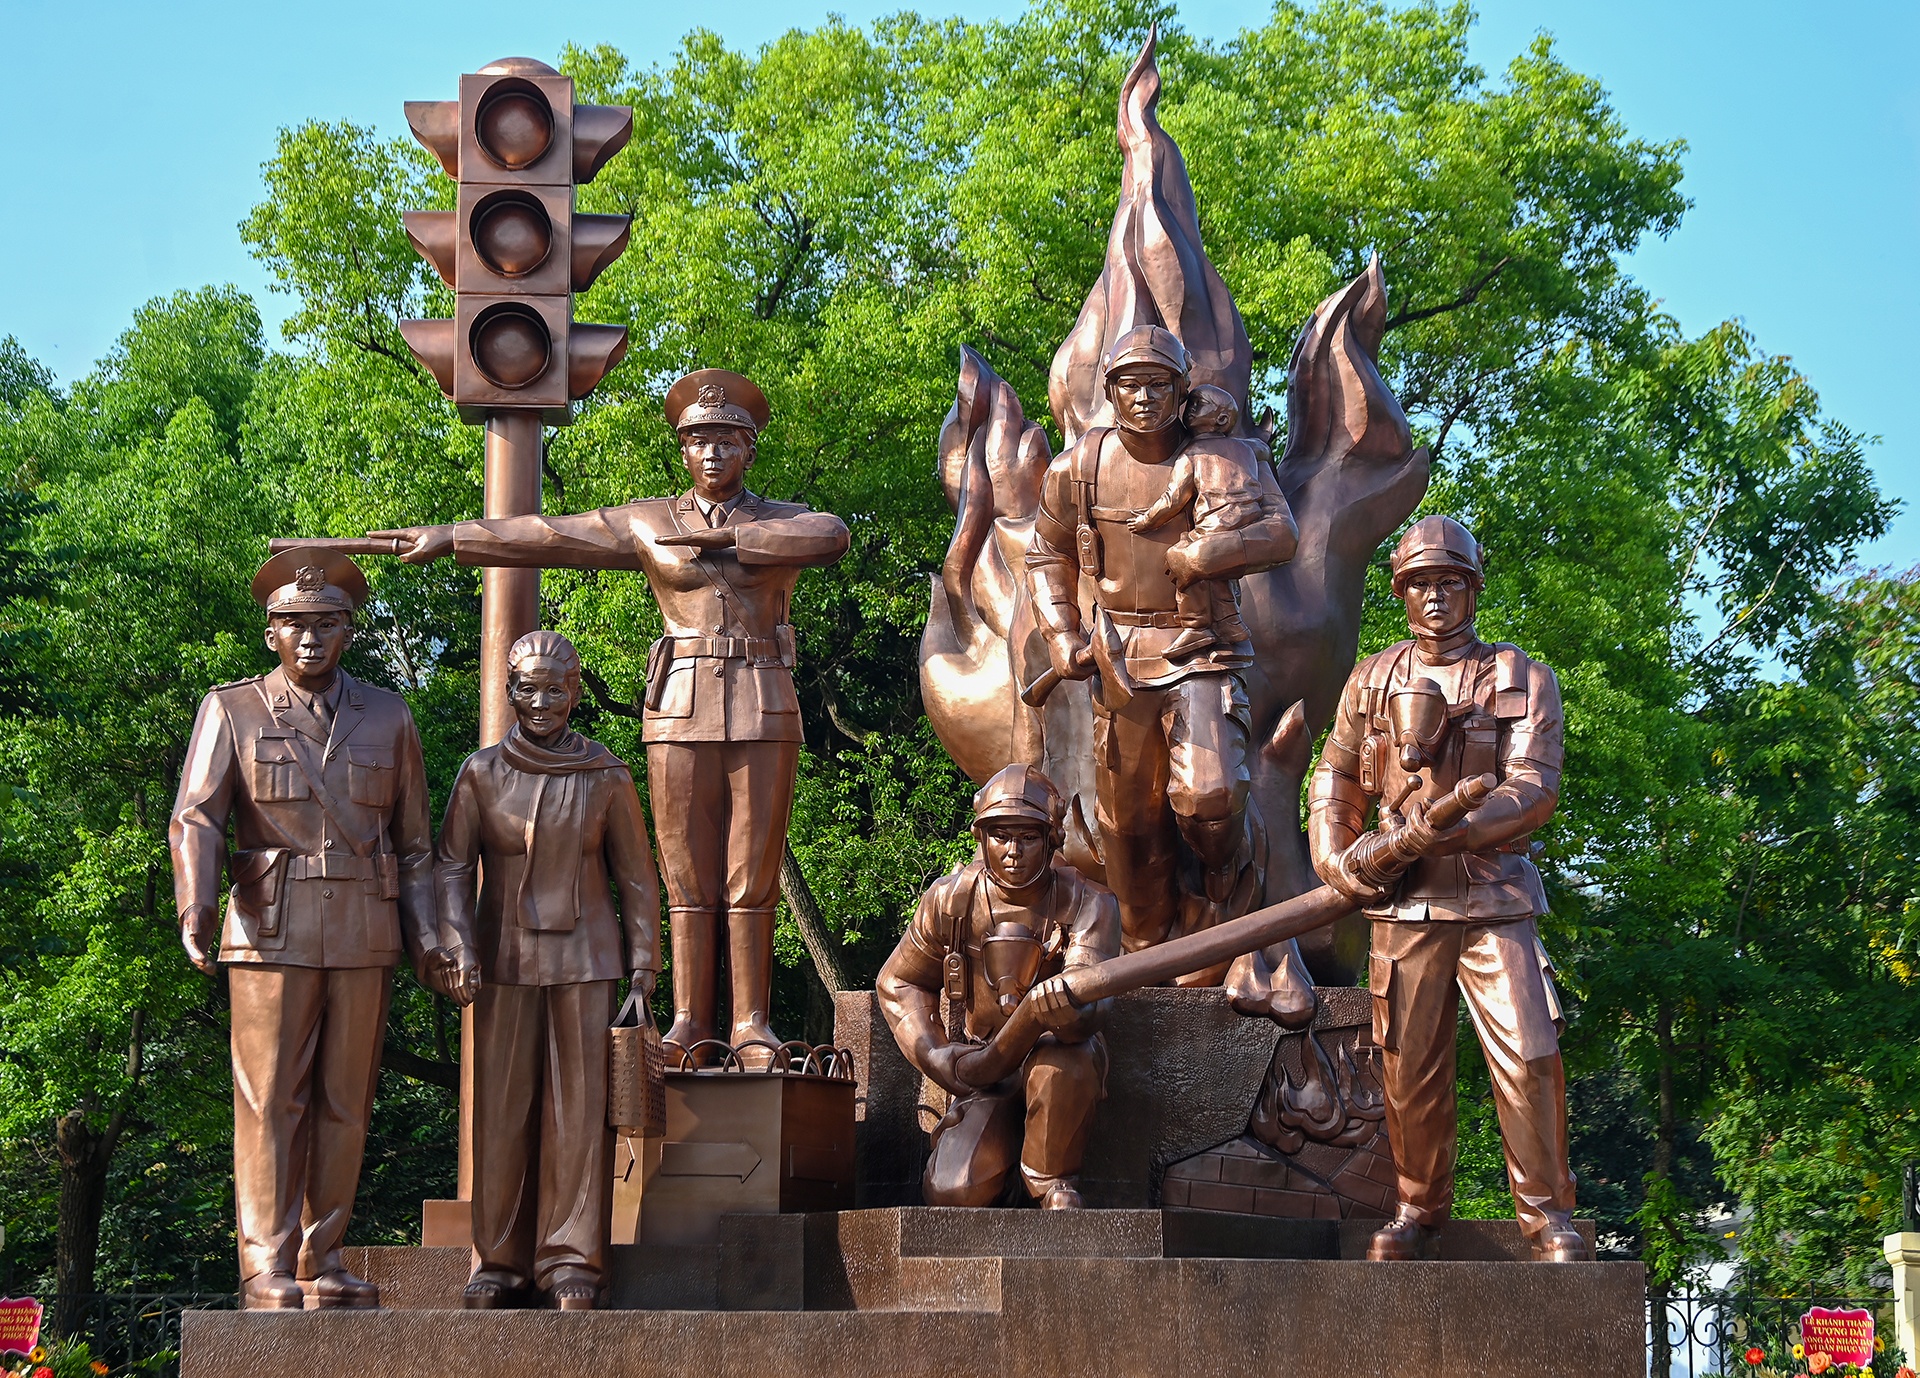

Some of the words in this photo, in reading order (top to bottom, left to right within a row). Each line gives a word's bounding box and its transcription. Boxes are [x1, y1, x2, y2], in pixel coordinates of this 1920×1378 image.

[1816, 1318, 1844, 1327] KHÁNH
[1847, 1319, 1872, 1328] THÀNH
[1813, 1327, 1848, 1336] TƯỢNG
[1850, 1326, 1866, 1337] ĐÀI
[1824, 1337, 1835, 1345] AN
[1836, 1336, 1858, 1346] NHÂN
